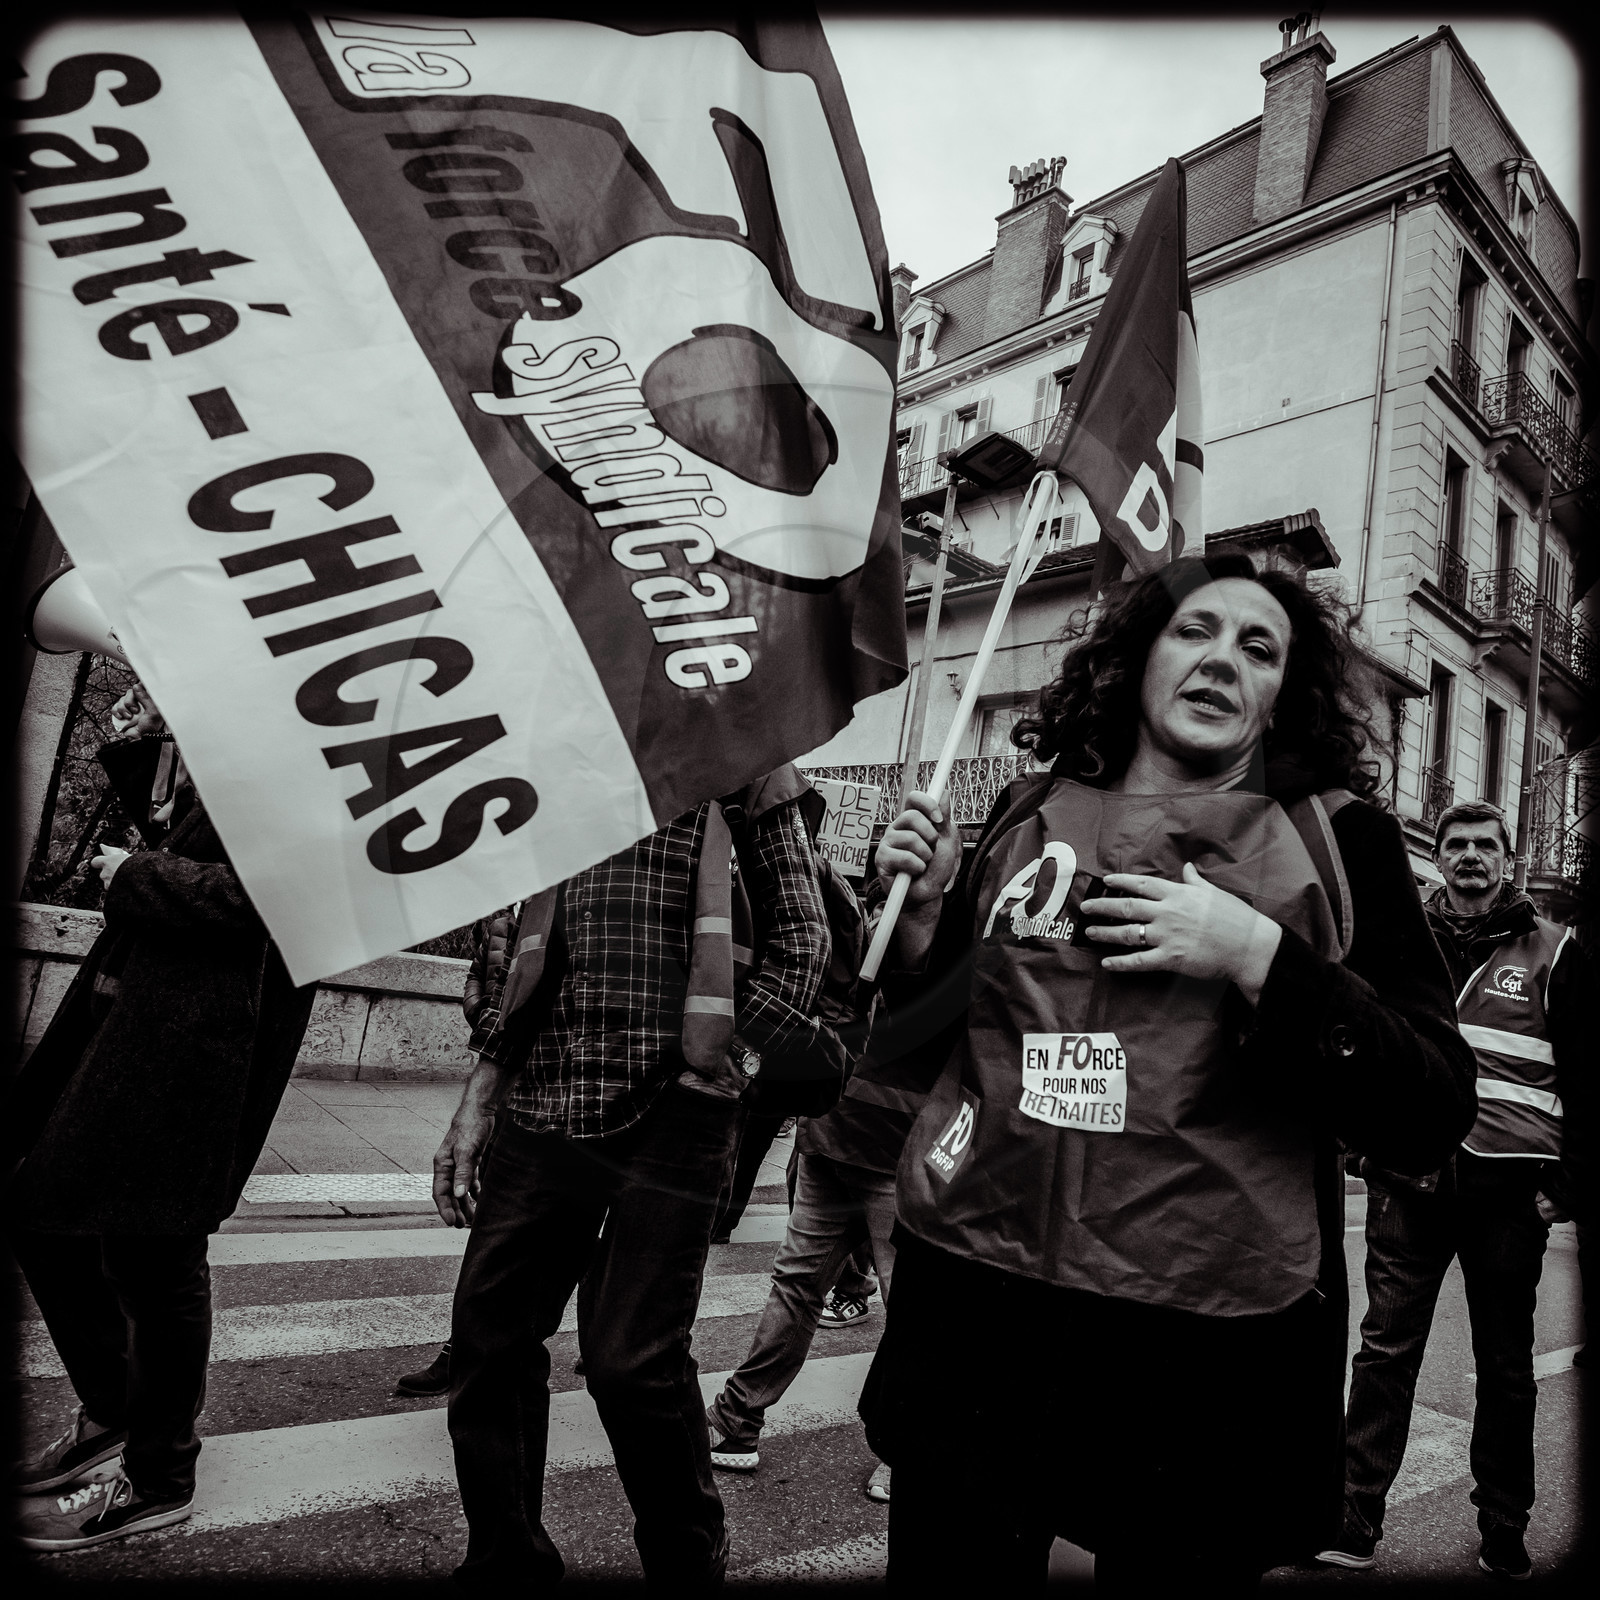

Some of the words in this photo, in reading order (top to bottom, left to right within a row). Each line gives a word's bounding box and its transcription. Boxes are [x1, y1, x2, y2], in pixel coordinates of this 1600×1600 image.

[323, 16, 475, 92] la
[384, 124, 583, 322] force
[8, 52, 291, 361] Santé
[187, 452, 539, 876] CHICAS
[470, 335, 760, 691] syndicale
[839, 784, 875, 813] DE
[818, 807, 873, 840] MES
[817, 837, 868, 867] RAÎCHE
[1484, 988, 1529, 1002] Hautes-Alpes
[1501, 979, 1523, 993] cgt
[1027, 1048, 1049, 1070] EN
[1057, 1035, 1125, 1071] FORCE
[1043, 1077, 1077, 1094] POUR
[1081, 1078, 1107, 1095] NOS
[1024, 1091, 1123, 1126] RETRAITES
[940, 1101, 974, 1156] FO
